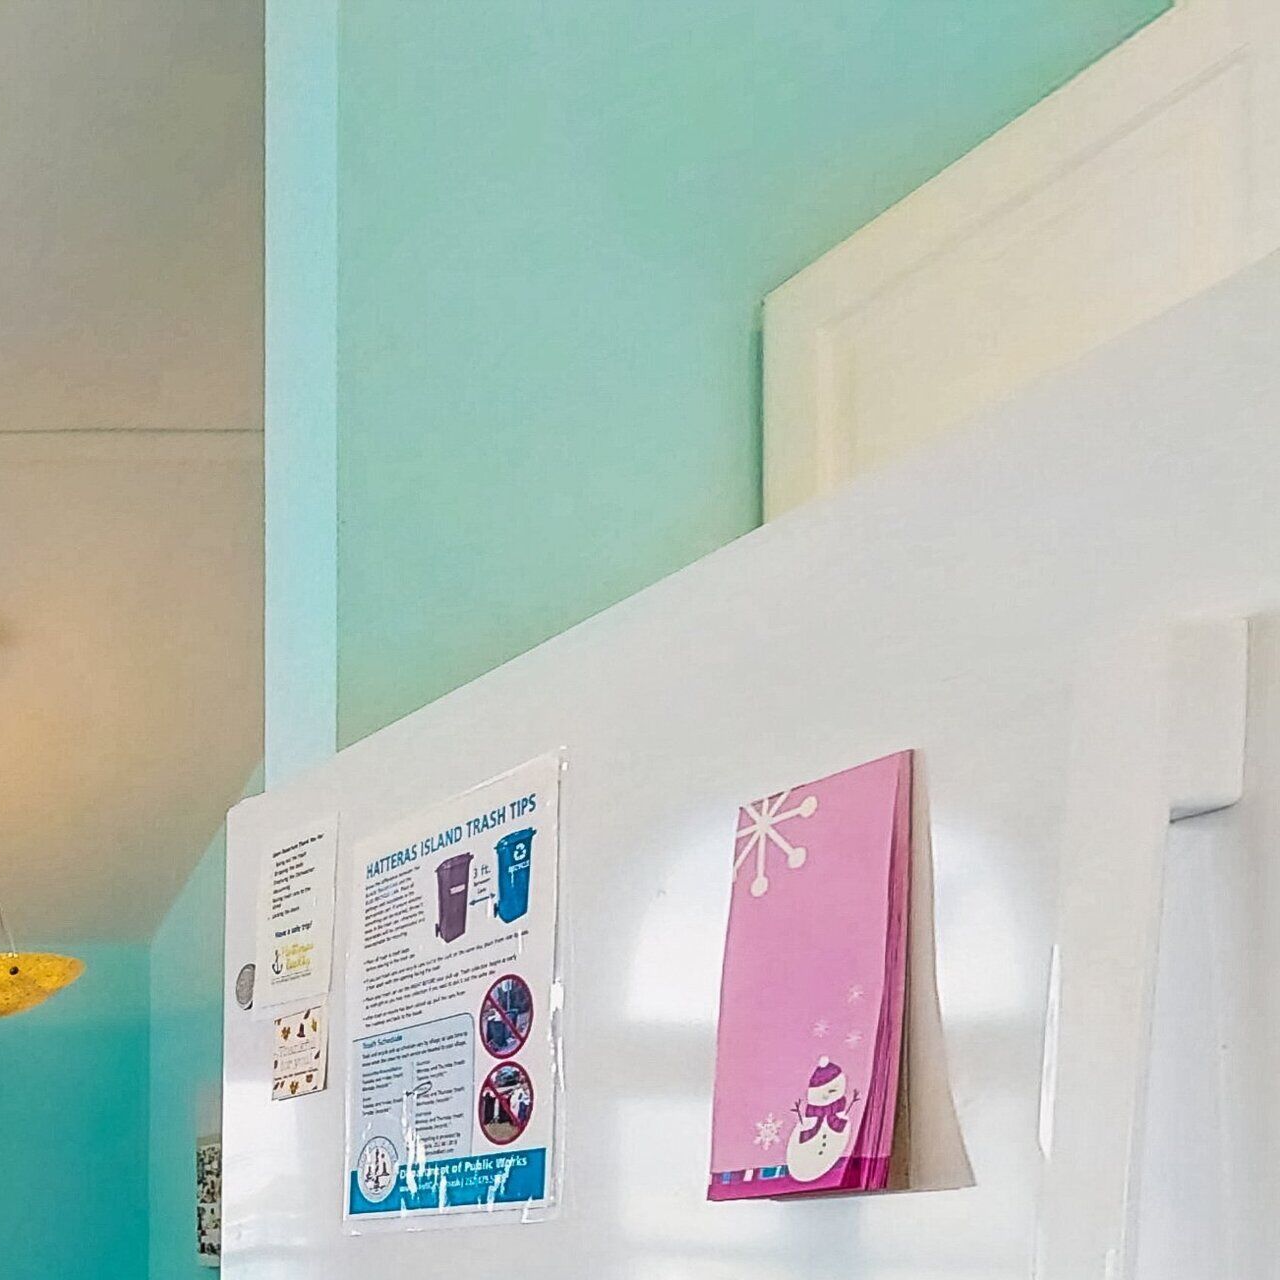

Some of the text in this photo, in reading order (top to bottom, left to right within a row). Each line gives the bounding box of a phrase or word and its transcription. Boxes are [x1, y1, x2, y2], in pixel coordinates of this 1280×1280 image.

[366, 792, 537, 880] HATTERAS ISLAND TRASH TIPS
[451, 1160, 463, 1174] of
[464, 1158, 494, 1173] Public
